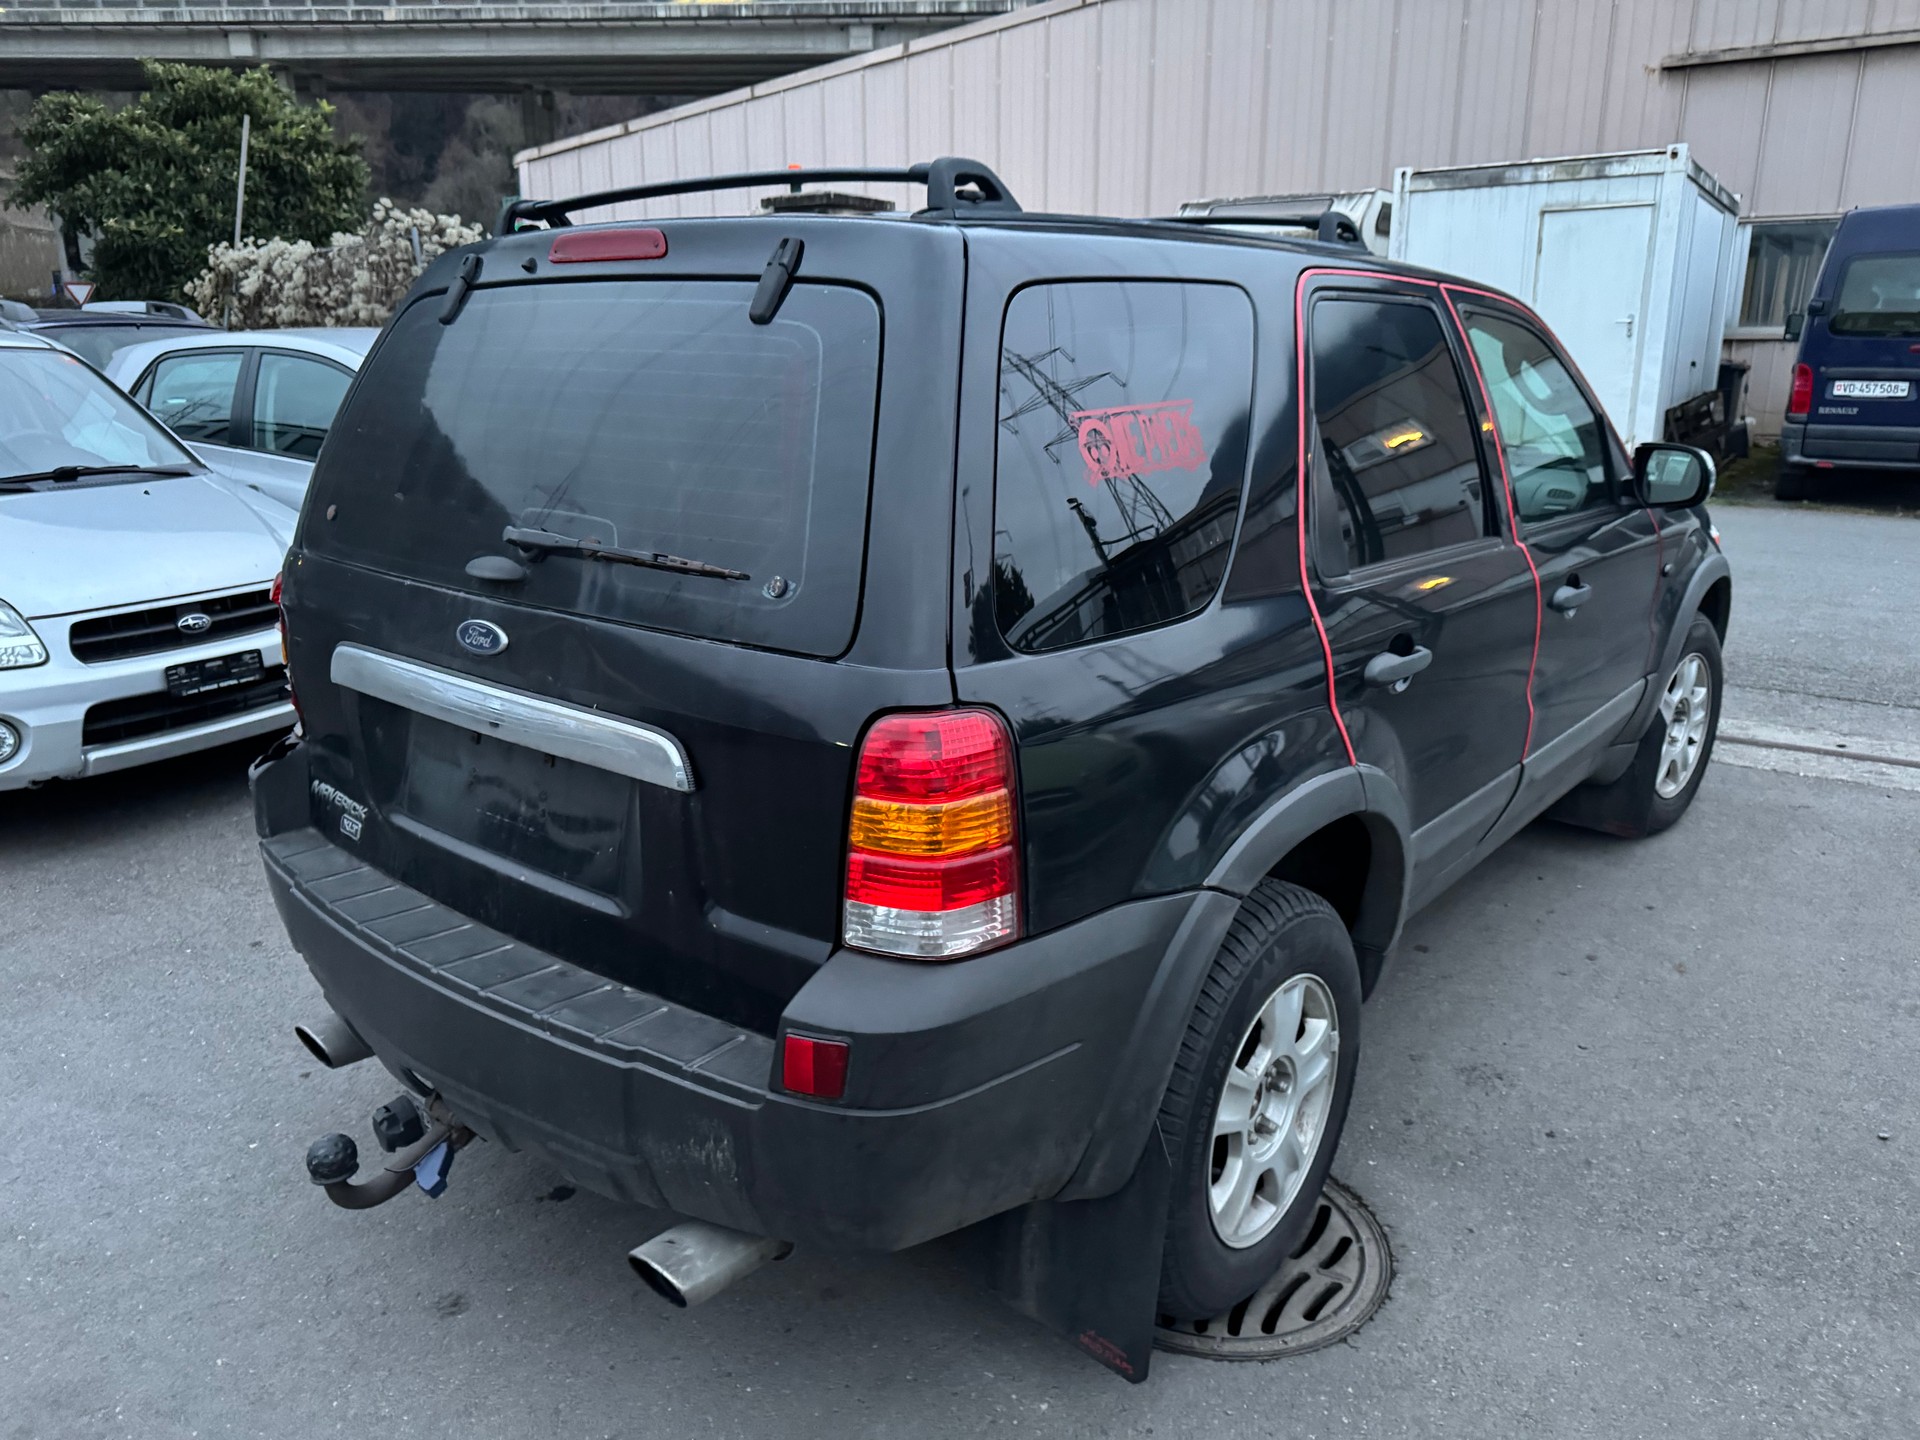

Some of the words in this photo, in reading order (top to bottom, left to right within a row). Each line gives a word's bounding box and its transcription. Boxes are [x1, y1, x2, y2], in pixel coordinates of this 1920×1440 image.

[1818, 406, 1859, 415] RENAULT
[465, 625, 493, 648] Ford
[311, 779, 368, 819] MAVERICK
